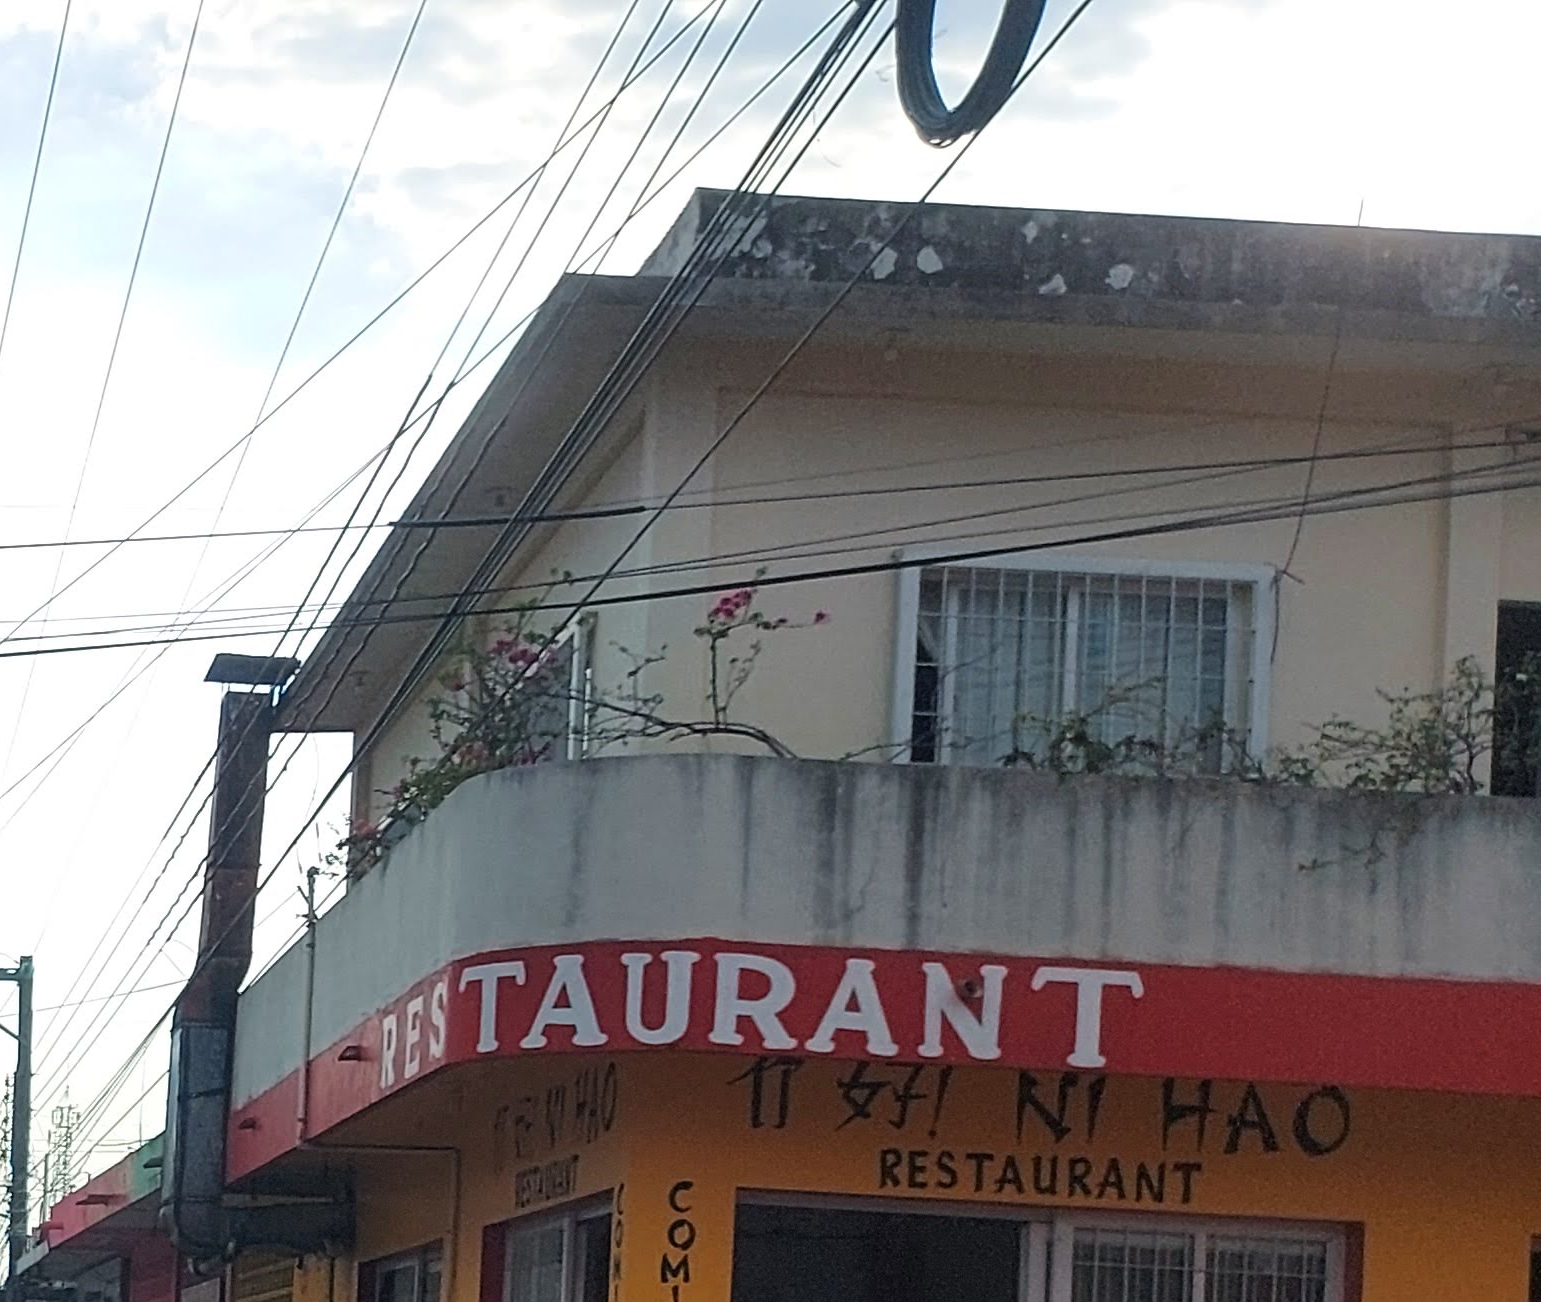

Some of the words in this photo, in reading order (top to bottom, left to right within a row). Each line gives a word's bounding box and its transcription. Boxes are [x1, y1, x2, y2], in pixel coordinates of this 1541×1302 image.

[379, 950, 1144, 1089] RESTAURANT
[1161, 1076, 1351, 1157] HAO
[878, 1147, 1202, 1206] RESTAURANT
